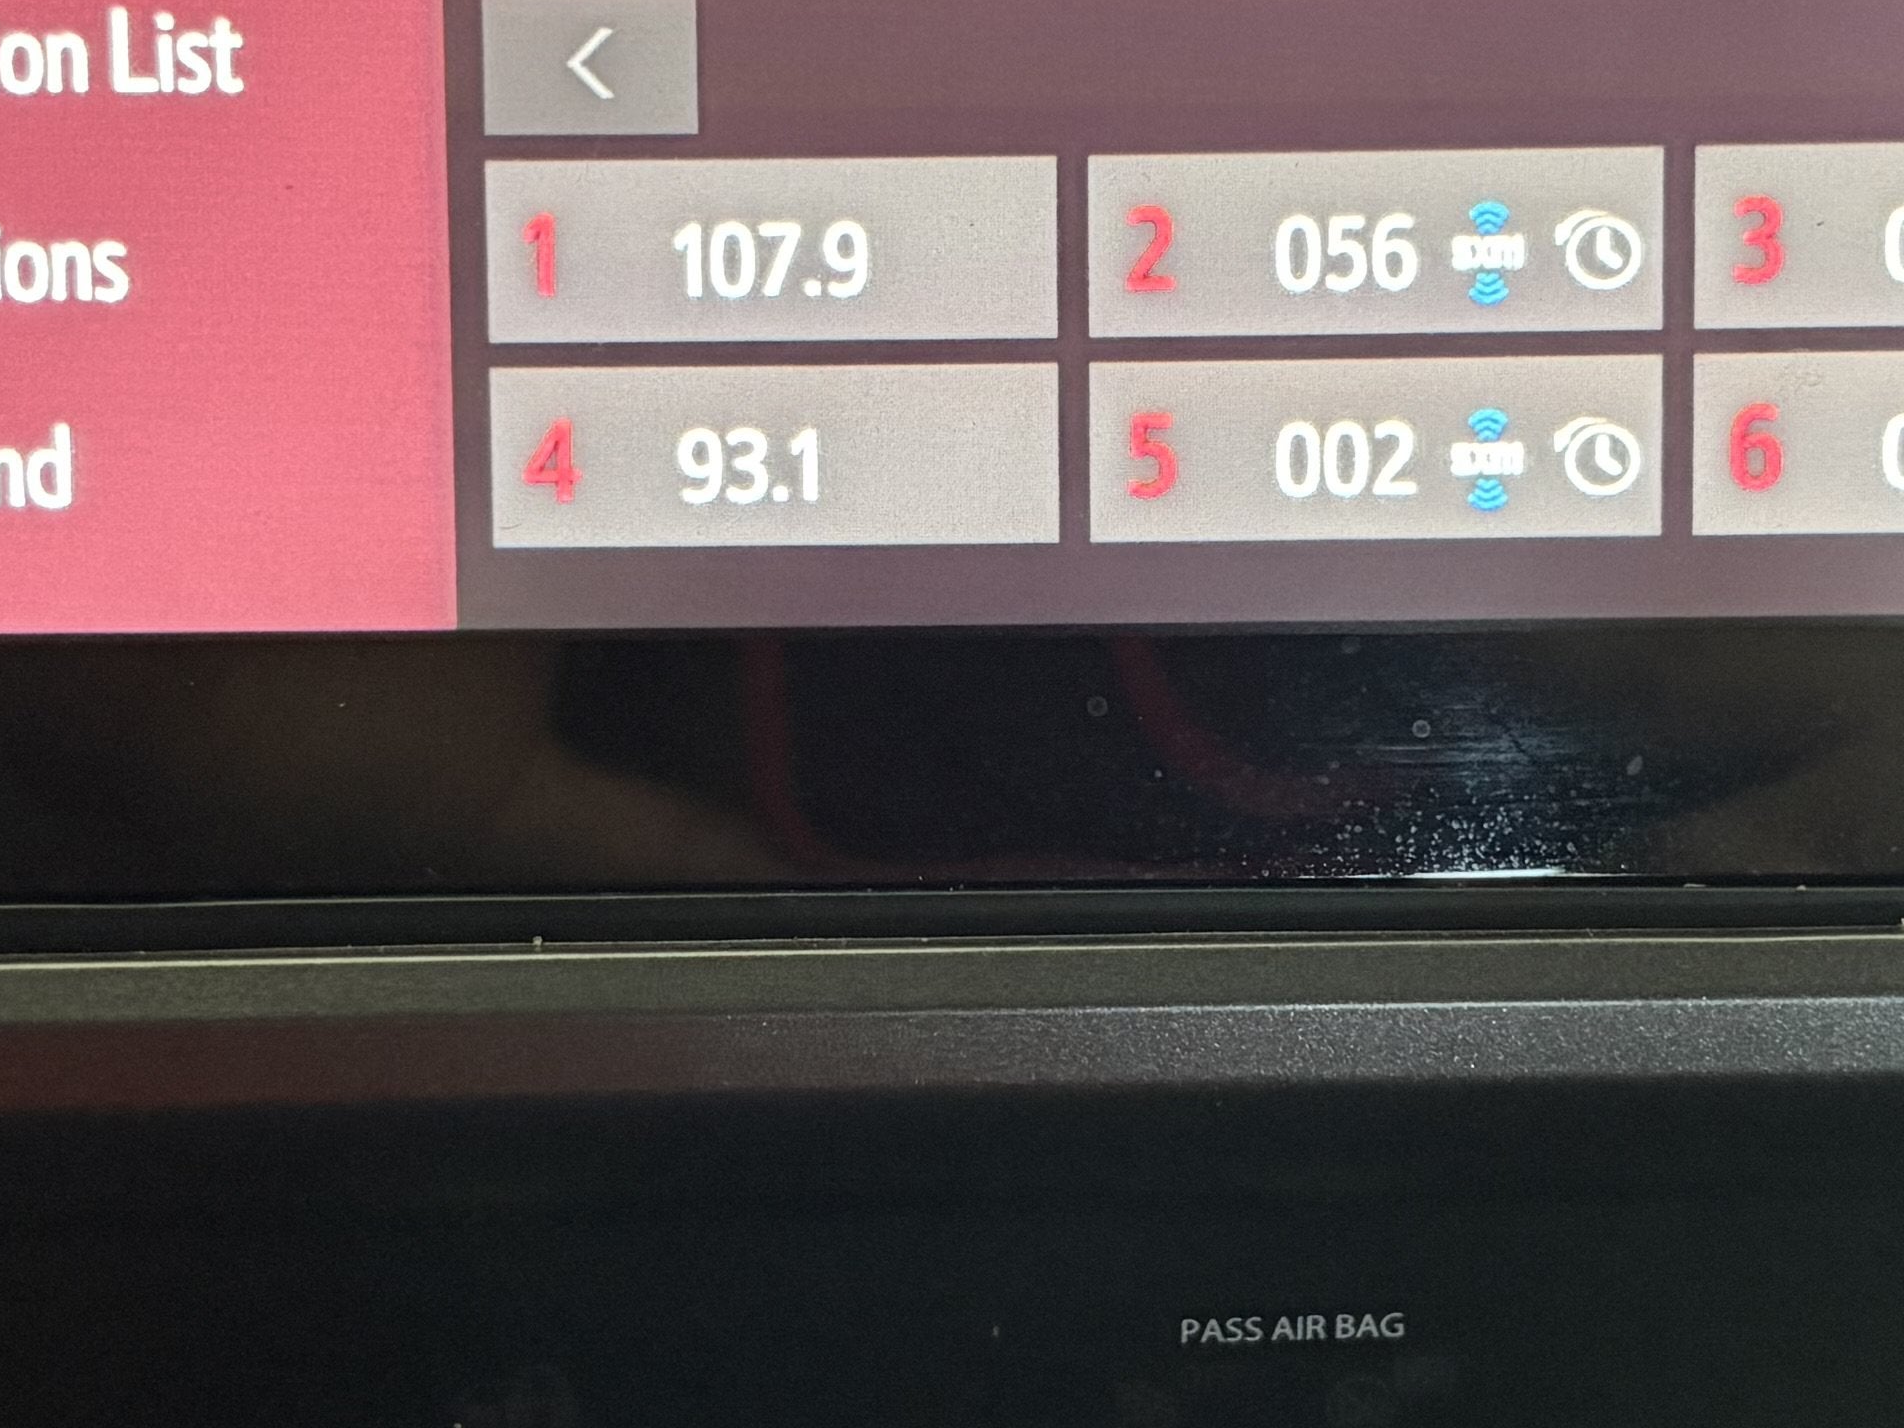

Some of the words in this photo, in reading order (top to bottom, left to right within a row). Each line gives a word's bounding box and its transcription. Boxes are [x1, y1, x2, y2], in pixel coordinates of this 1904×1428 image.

[109, 7, 245, 95] List
[521, 211, 558, 298] 1
[673, 220, 870, 298] 107.9
[1125, 204, 1177, 293] 2
[1275, 213, 1418, 294] 056
[1732, 193, 1786, 286] 3
[521, 417, 583, 504] 4
[676, 426, 820, 505] 93.1
[1127, 411, 1178, 500] 5
[1275, 419, 1417, 498] 002
[1729, 402, 1785, 492] 6
[1181, 1317, 1263, 1344] PASS
[1271, 1314, 1327, 1341] AIR
[1335, 1312, 1406, 1339] BAG
